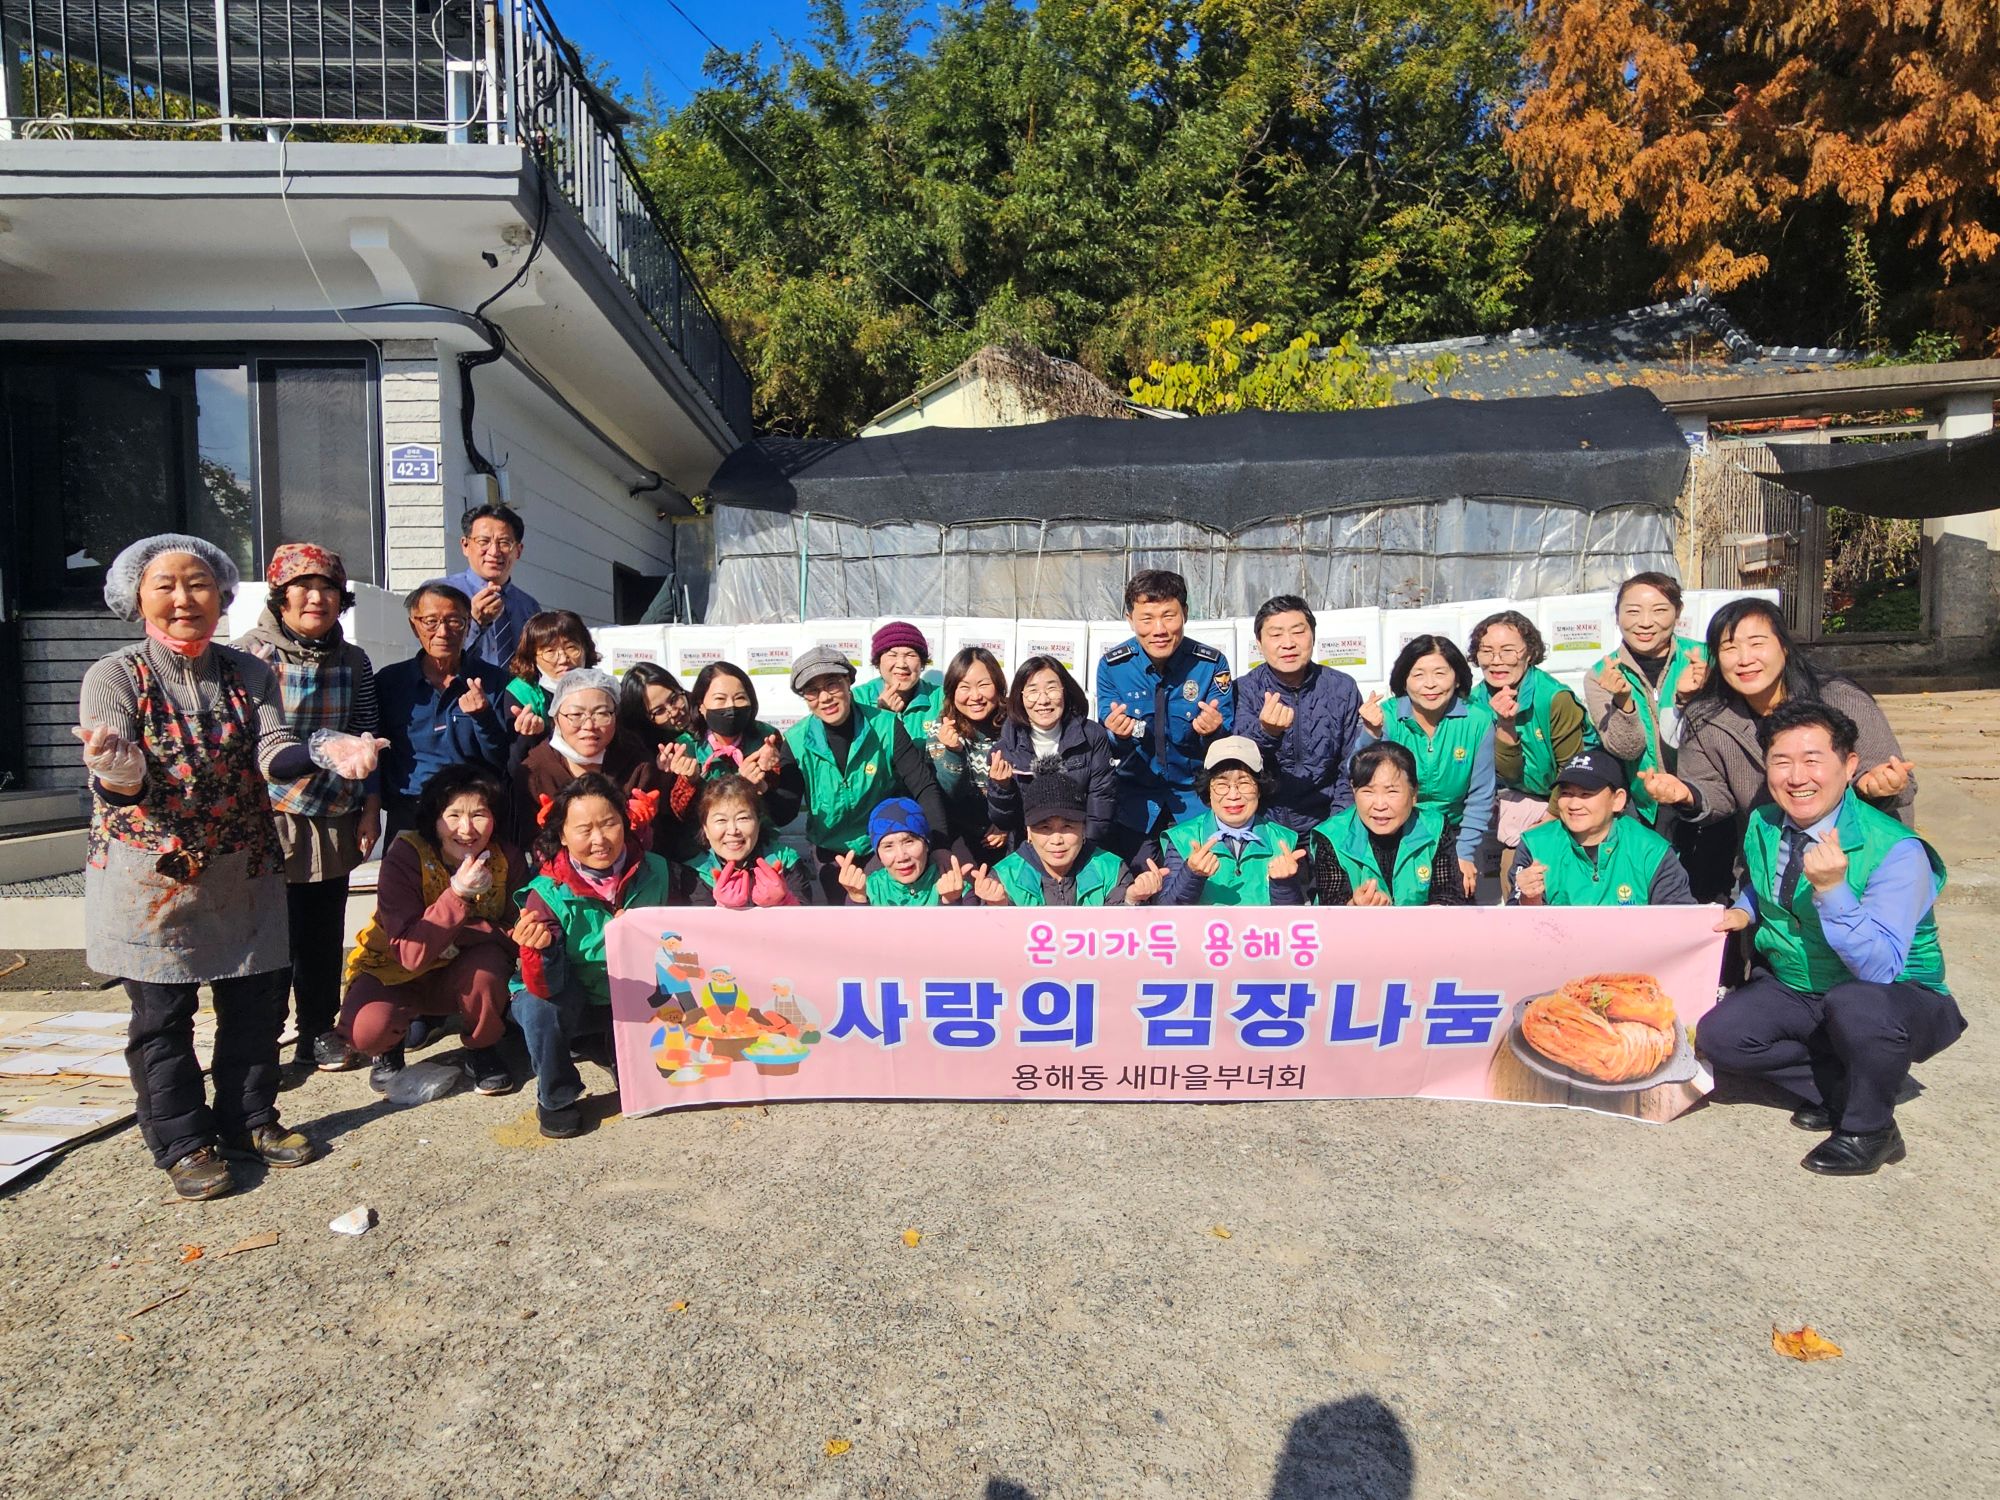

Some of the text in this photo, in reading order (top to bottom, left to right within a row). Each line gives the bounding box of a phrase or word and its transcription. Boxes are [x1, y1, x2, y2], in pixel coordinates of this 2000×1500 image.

[396, 462, 429, 476] 42-3
[1027, 923, 1319, 967] 온기가득 용해동
[827, 981, 1503, 1048] 사랑의 김장나눔
[1011, 1064, 1307, 1091] 용해동 새마을부녀회
